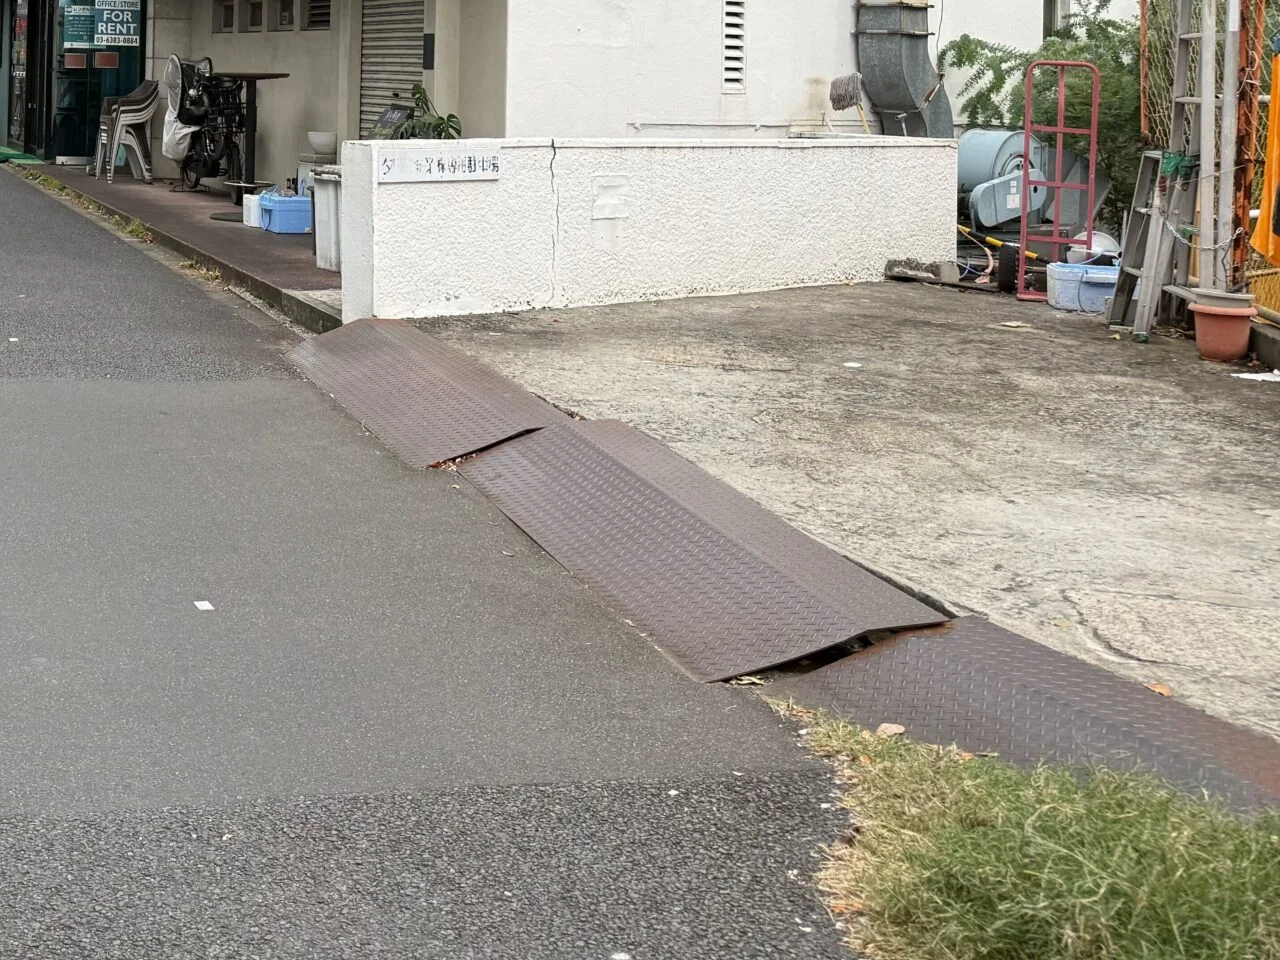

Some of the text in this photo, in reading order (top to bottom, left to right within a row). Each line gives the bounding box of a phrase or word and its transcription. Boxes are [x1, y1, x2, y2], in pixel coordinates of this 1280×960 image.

[96, 0, 140, 9] OFFICE/STORE
[103, 10, 132, 22] FOR
[97, 22, 137, 35] RENT
